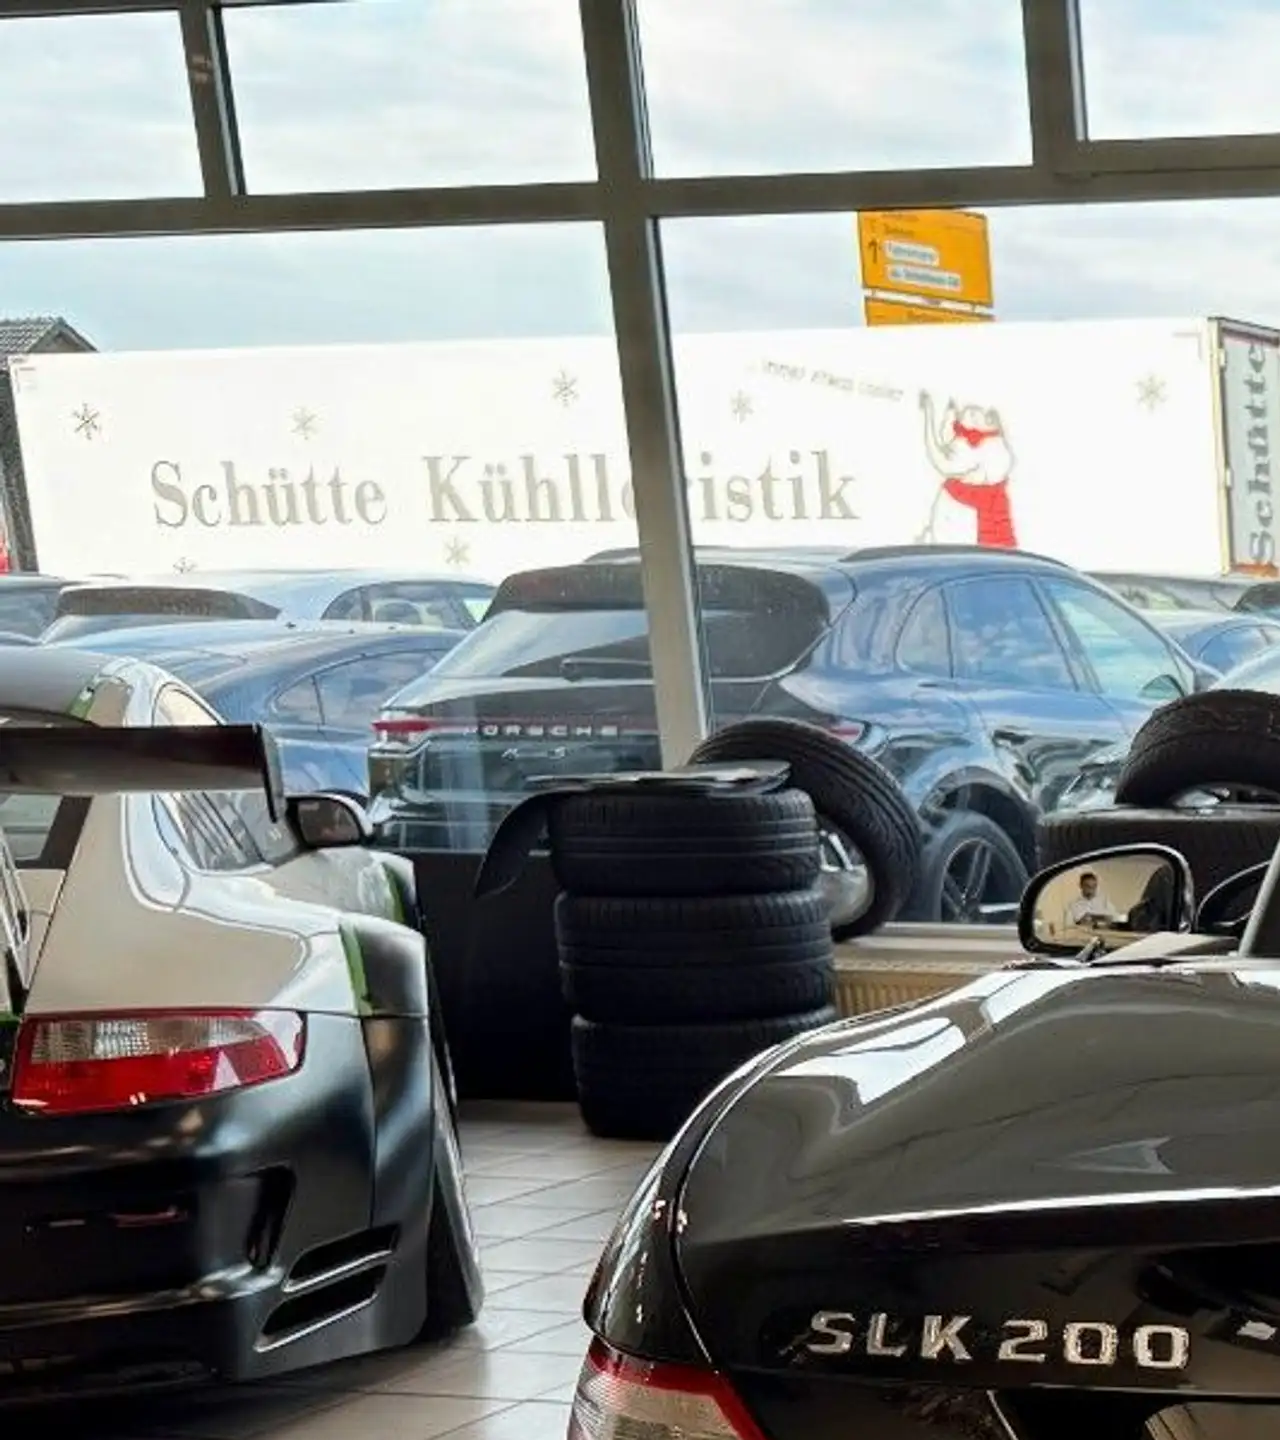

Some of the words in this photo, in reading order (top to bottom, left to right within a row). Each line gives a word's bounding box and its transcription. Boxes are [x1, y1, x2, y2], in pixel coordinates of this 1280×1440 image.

[1243, 342, 1275, 563] Schütte
[150, 459, 388, 528] Schütte
[420, 448, 861, 524] Kühllistik
[462, 723, 619, 737] PORSCHE
[805, 1309, 974, 1362] SLK
[998, 1318, 1191, 1370] 200
